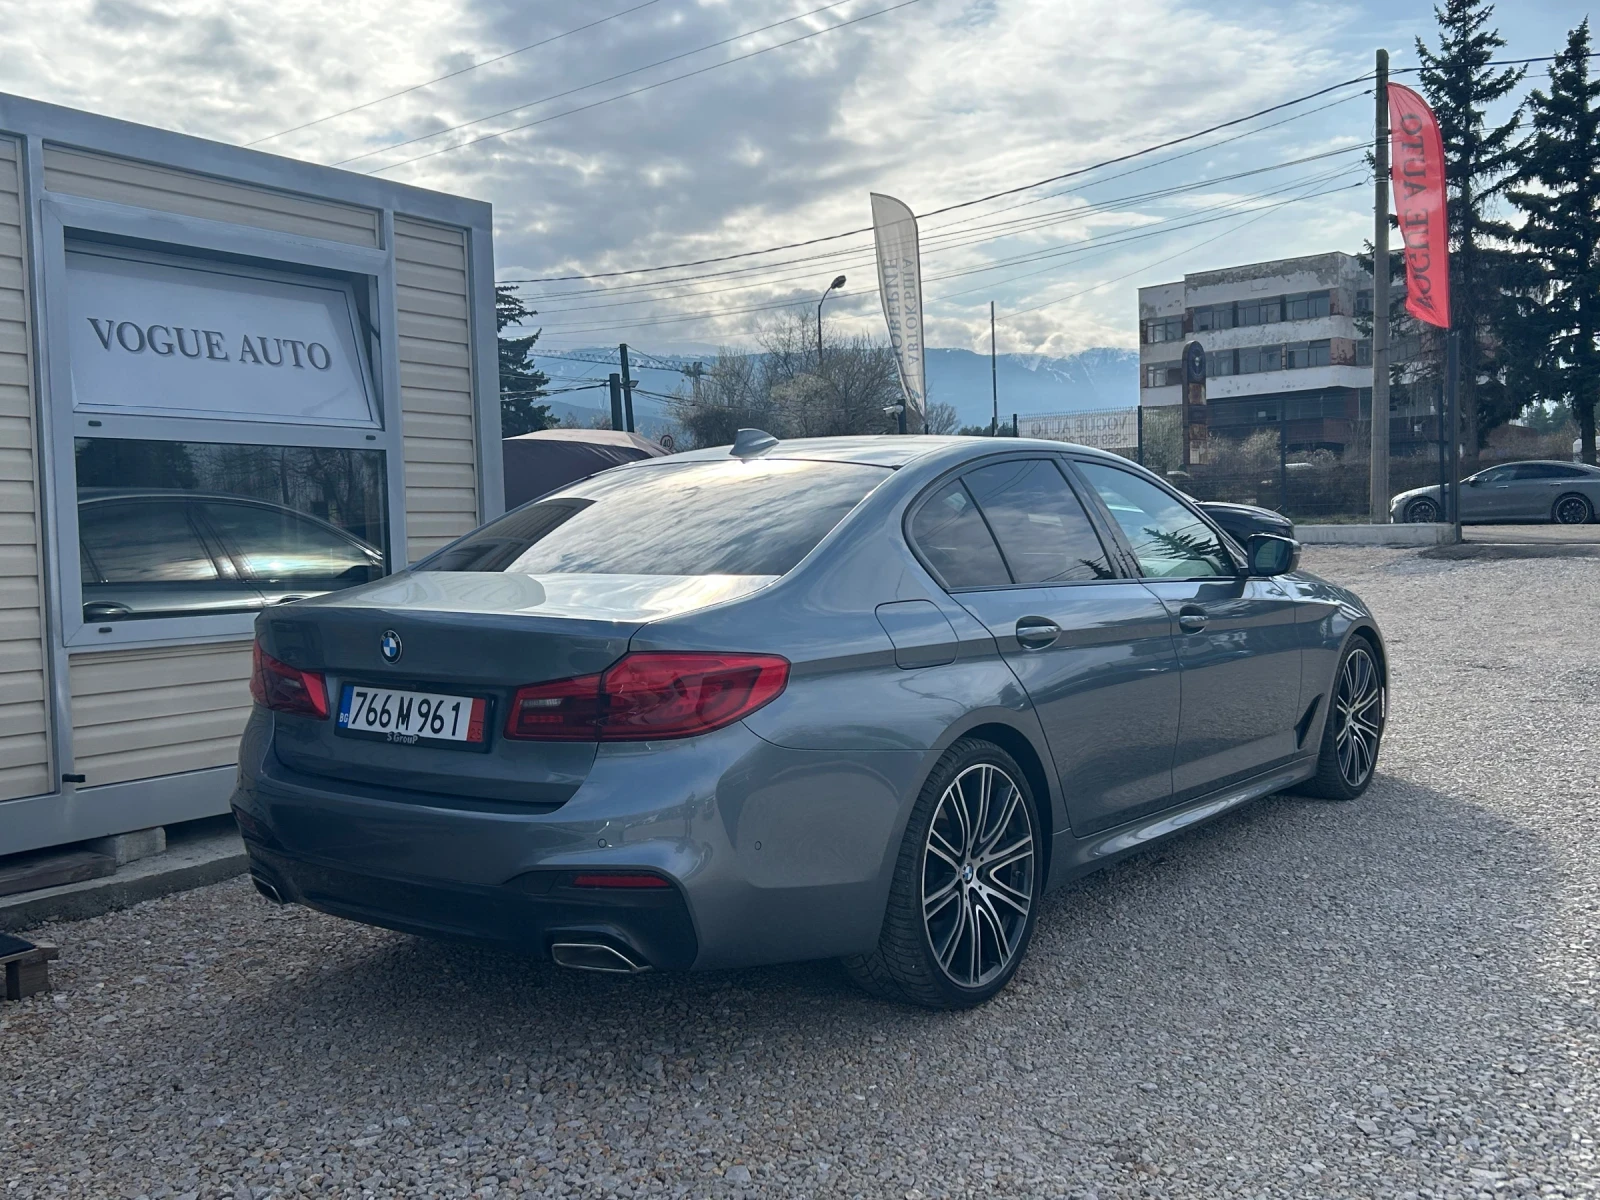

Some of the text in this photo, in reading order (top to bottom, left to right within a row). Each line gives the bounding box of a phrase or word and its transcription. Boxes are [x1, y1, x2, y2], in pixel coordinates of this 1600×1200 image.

[87, 318, 331, 370] VOGUE AUTO
[663, 439, 670, 447] 40
[339, 712, 349, 723] BG
